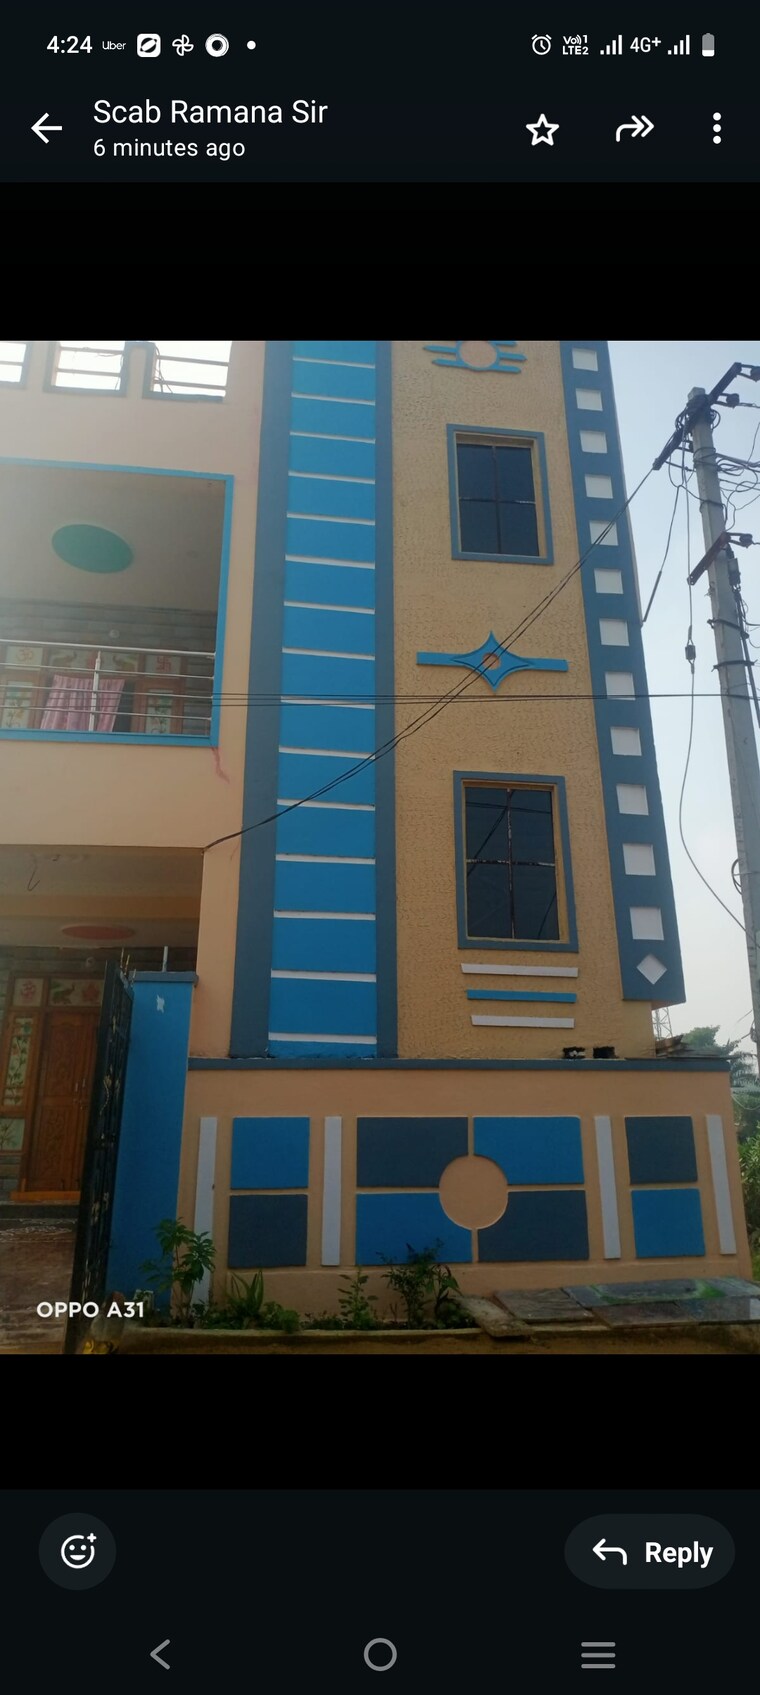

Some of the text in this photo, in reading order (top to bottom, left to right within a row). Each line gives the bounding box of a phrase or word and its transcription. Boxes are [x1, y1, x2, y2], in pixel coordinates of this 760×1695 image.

[46, 35, 127, 54] 4:24 Uber
[562, 45, 589, 56] LTE2
[629, 36, 662, 53] 4G+
[93, 98, 329, 124] Scab Ramana Sir
[93, 138, 246, 162] 6 minutes ago
[645, 1540, 714, 1569] Reply
